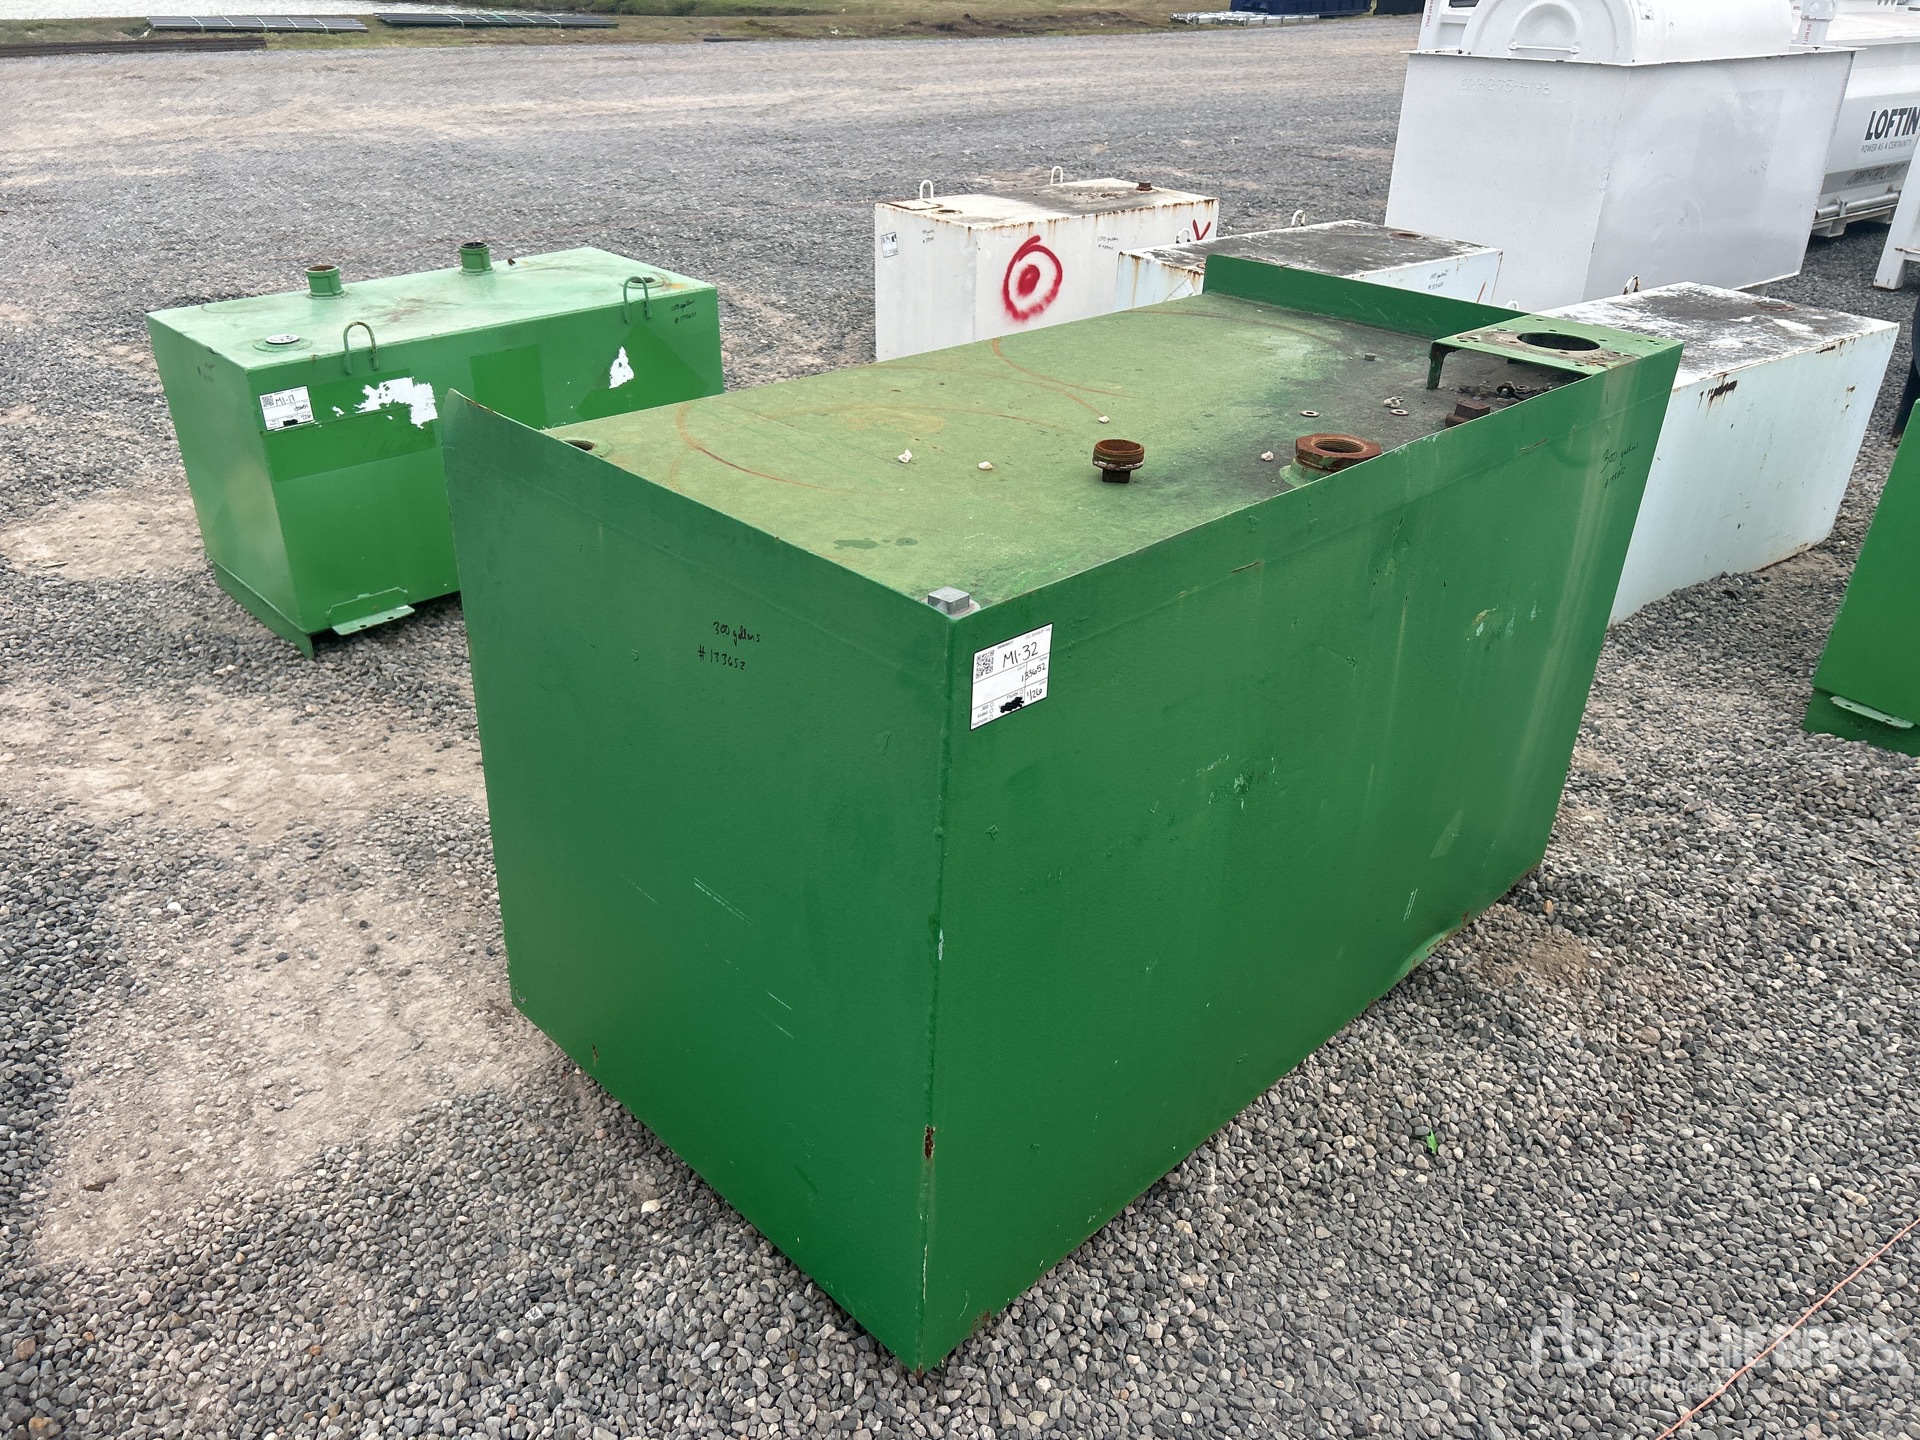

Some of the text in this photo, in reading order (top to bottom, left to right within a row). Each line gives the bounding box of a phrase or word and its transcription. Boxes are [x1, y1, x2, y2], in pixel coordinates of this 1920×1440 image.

[1864, 106, 1920, 141] LOFTIN
[713, 621, 730, 635] 300
[1021, 662, 1047, 682] 133652
